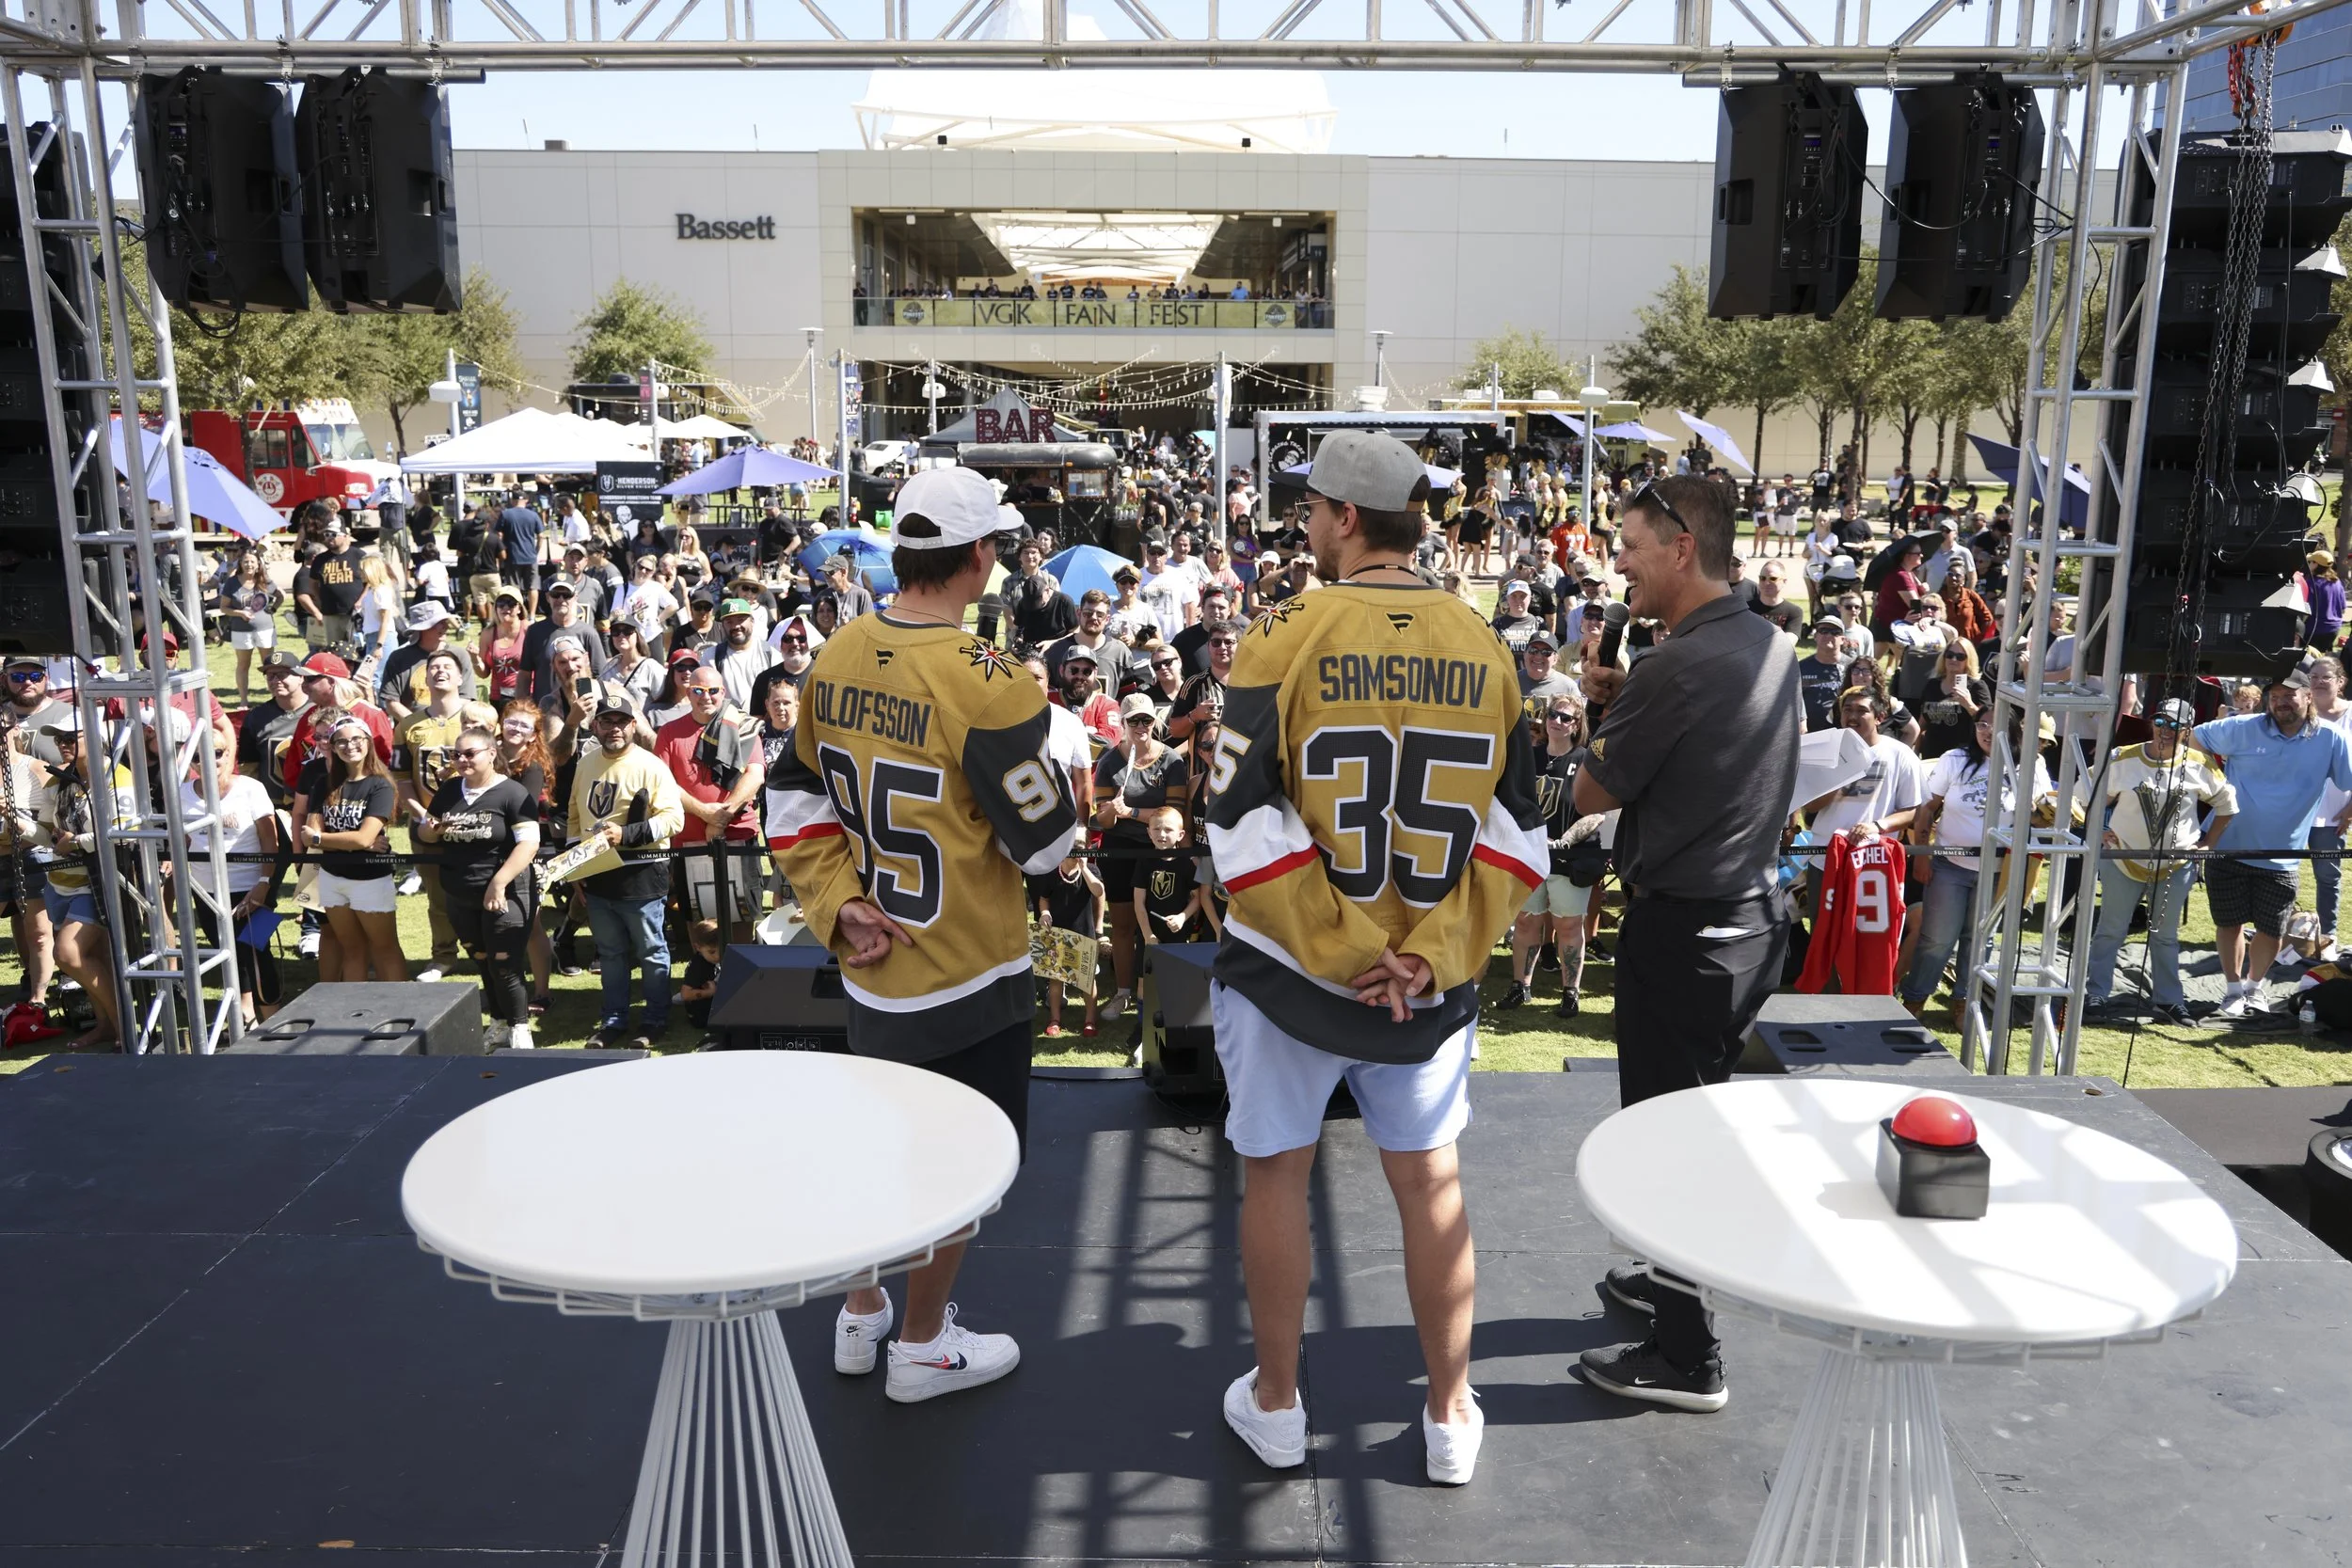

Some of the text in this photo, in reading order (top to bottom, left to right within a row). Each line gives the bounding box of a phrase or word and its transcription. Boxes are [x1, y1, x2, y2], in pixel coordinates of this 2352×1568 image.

[675, 213, 776, 240] Bassett
[977, 302, 1205, 325] VGK FAN FEST
[976, 408, 1057, 444] BAR
[323, 560, 352, 574] HILL
[323, 570, 354, 584] YEAH
[1318, 654, 1488, 708] SAMSONOV
[814, 680, 931, 749] OLOFSSON
[1001, 737, 1057, 825] 9
[1566, 762, 1577, 776] C
[817, 740, 945, 929] 95
[1193, 815, 1204, 826] MY
[1301, 724, 1497, 909] 35
[1856, 869, 1890, 933] 9
